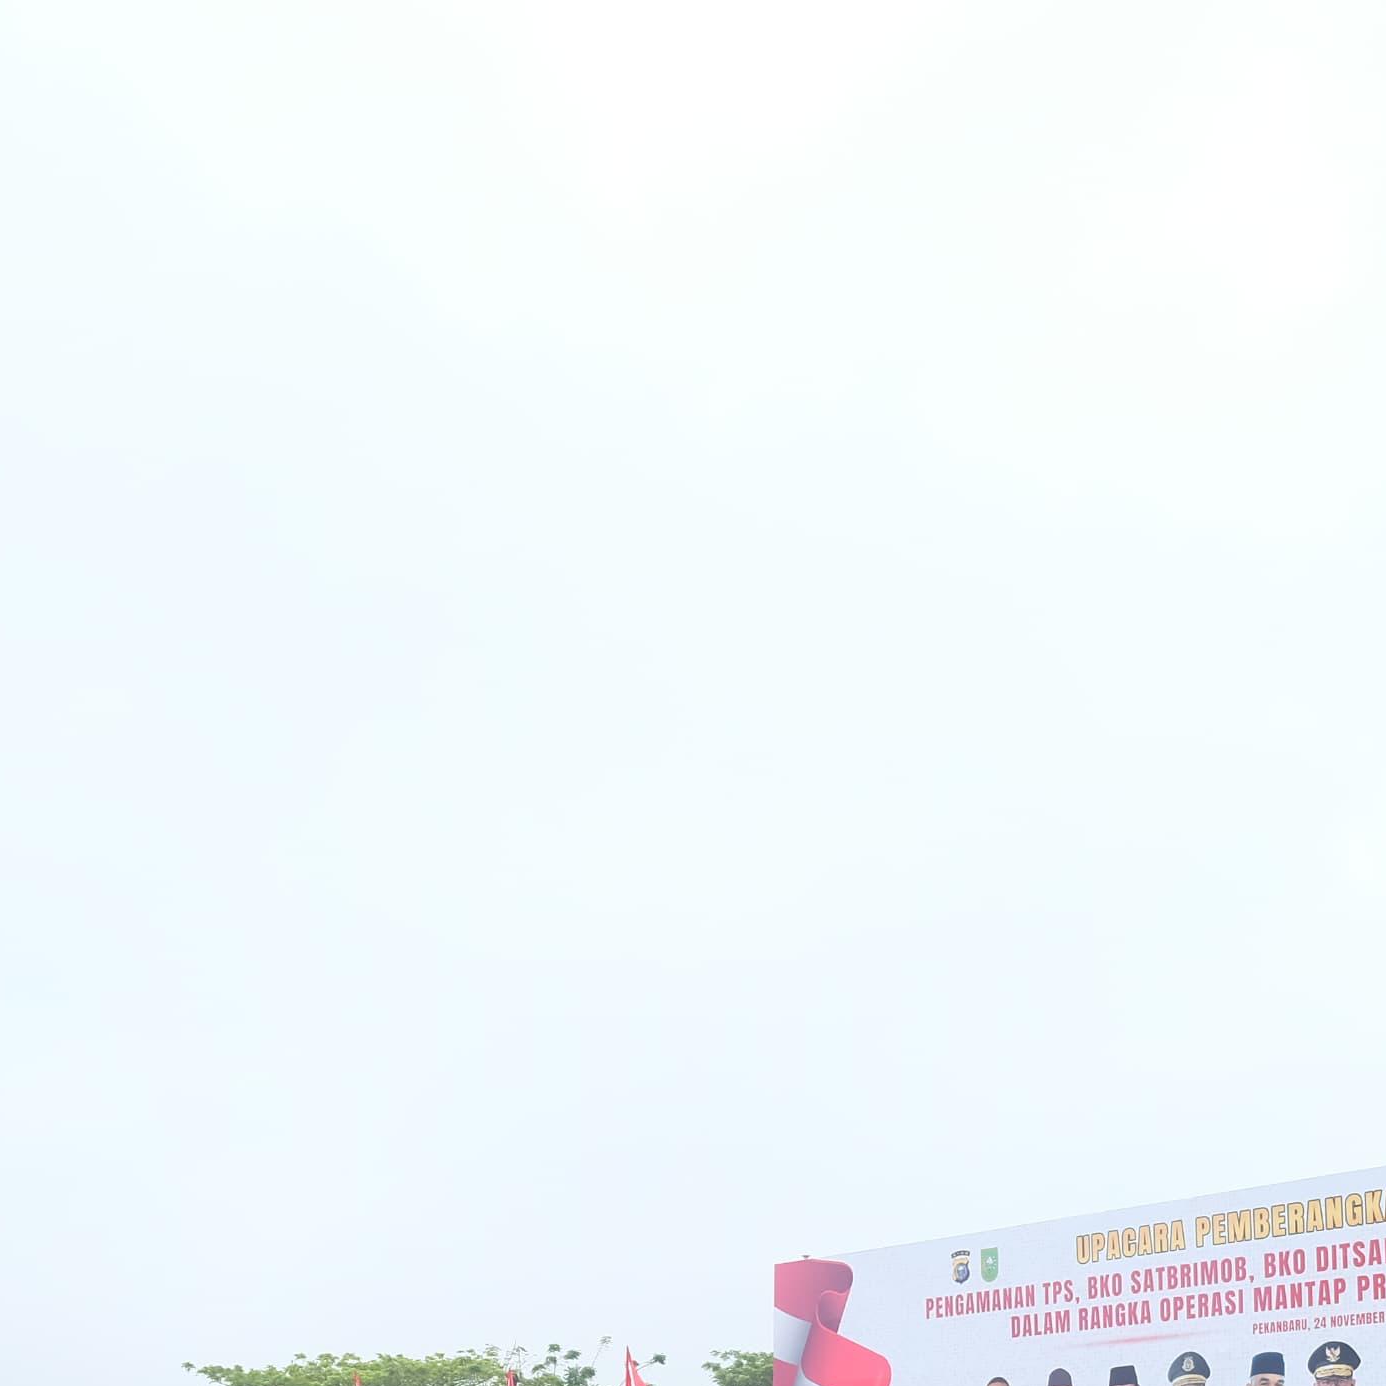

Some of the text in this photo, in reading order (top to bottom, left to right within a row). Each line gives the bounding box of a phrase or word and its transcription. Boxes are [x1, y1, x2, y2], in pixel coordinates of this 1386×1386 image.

[1076, 1220, 1186, 1264] UPACARA
[925, 1285, 1035, 1319] PENGAMANAN
[1042, 1279, 1080, 1305] TPS,
[1088, 1272, 1122, 1300] BKO
[1130, 1256, 1255, 1295] SATBRIMOB,
[1264, 1248, 1306, 1279] BKO
[1011, 1309, 1071, 1339] DALAM
[1078, 1299, 1152, 1331] RANGKA
[1159, 1289, 1244, 1322] OPERASI
[1253, 1278, 1347, 1313] MANTAP
[1252, 1318, 1311, 1335] PEKANBARU,
[1313, 1316, 1327, 1329] 24
[1330, 1311, 1385, 1328] NOVEMBER
